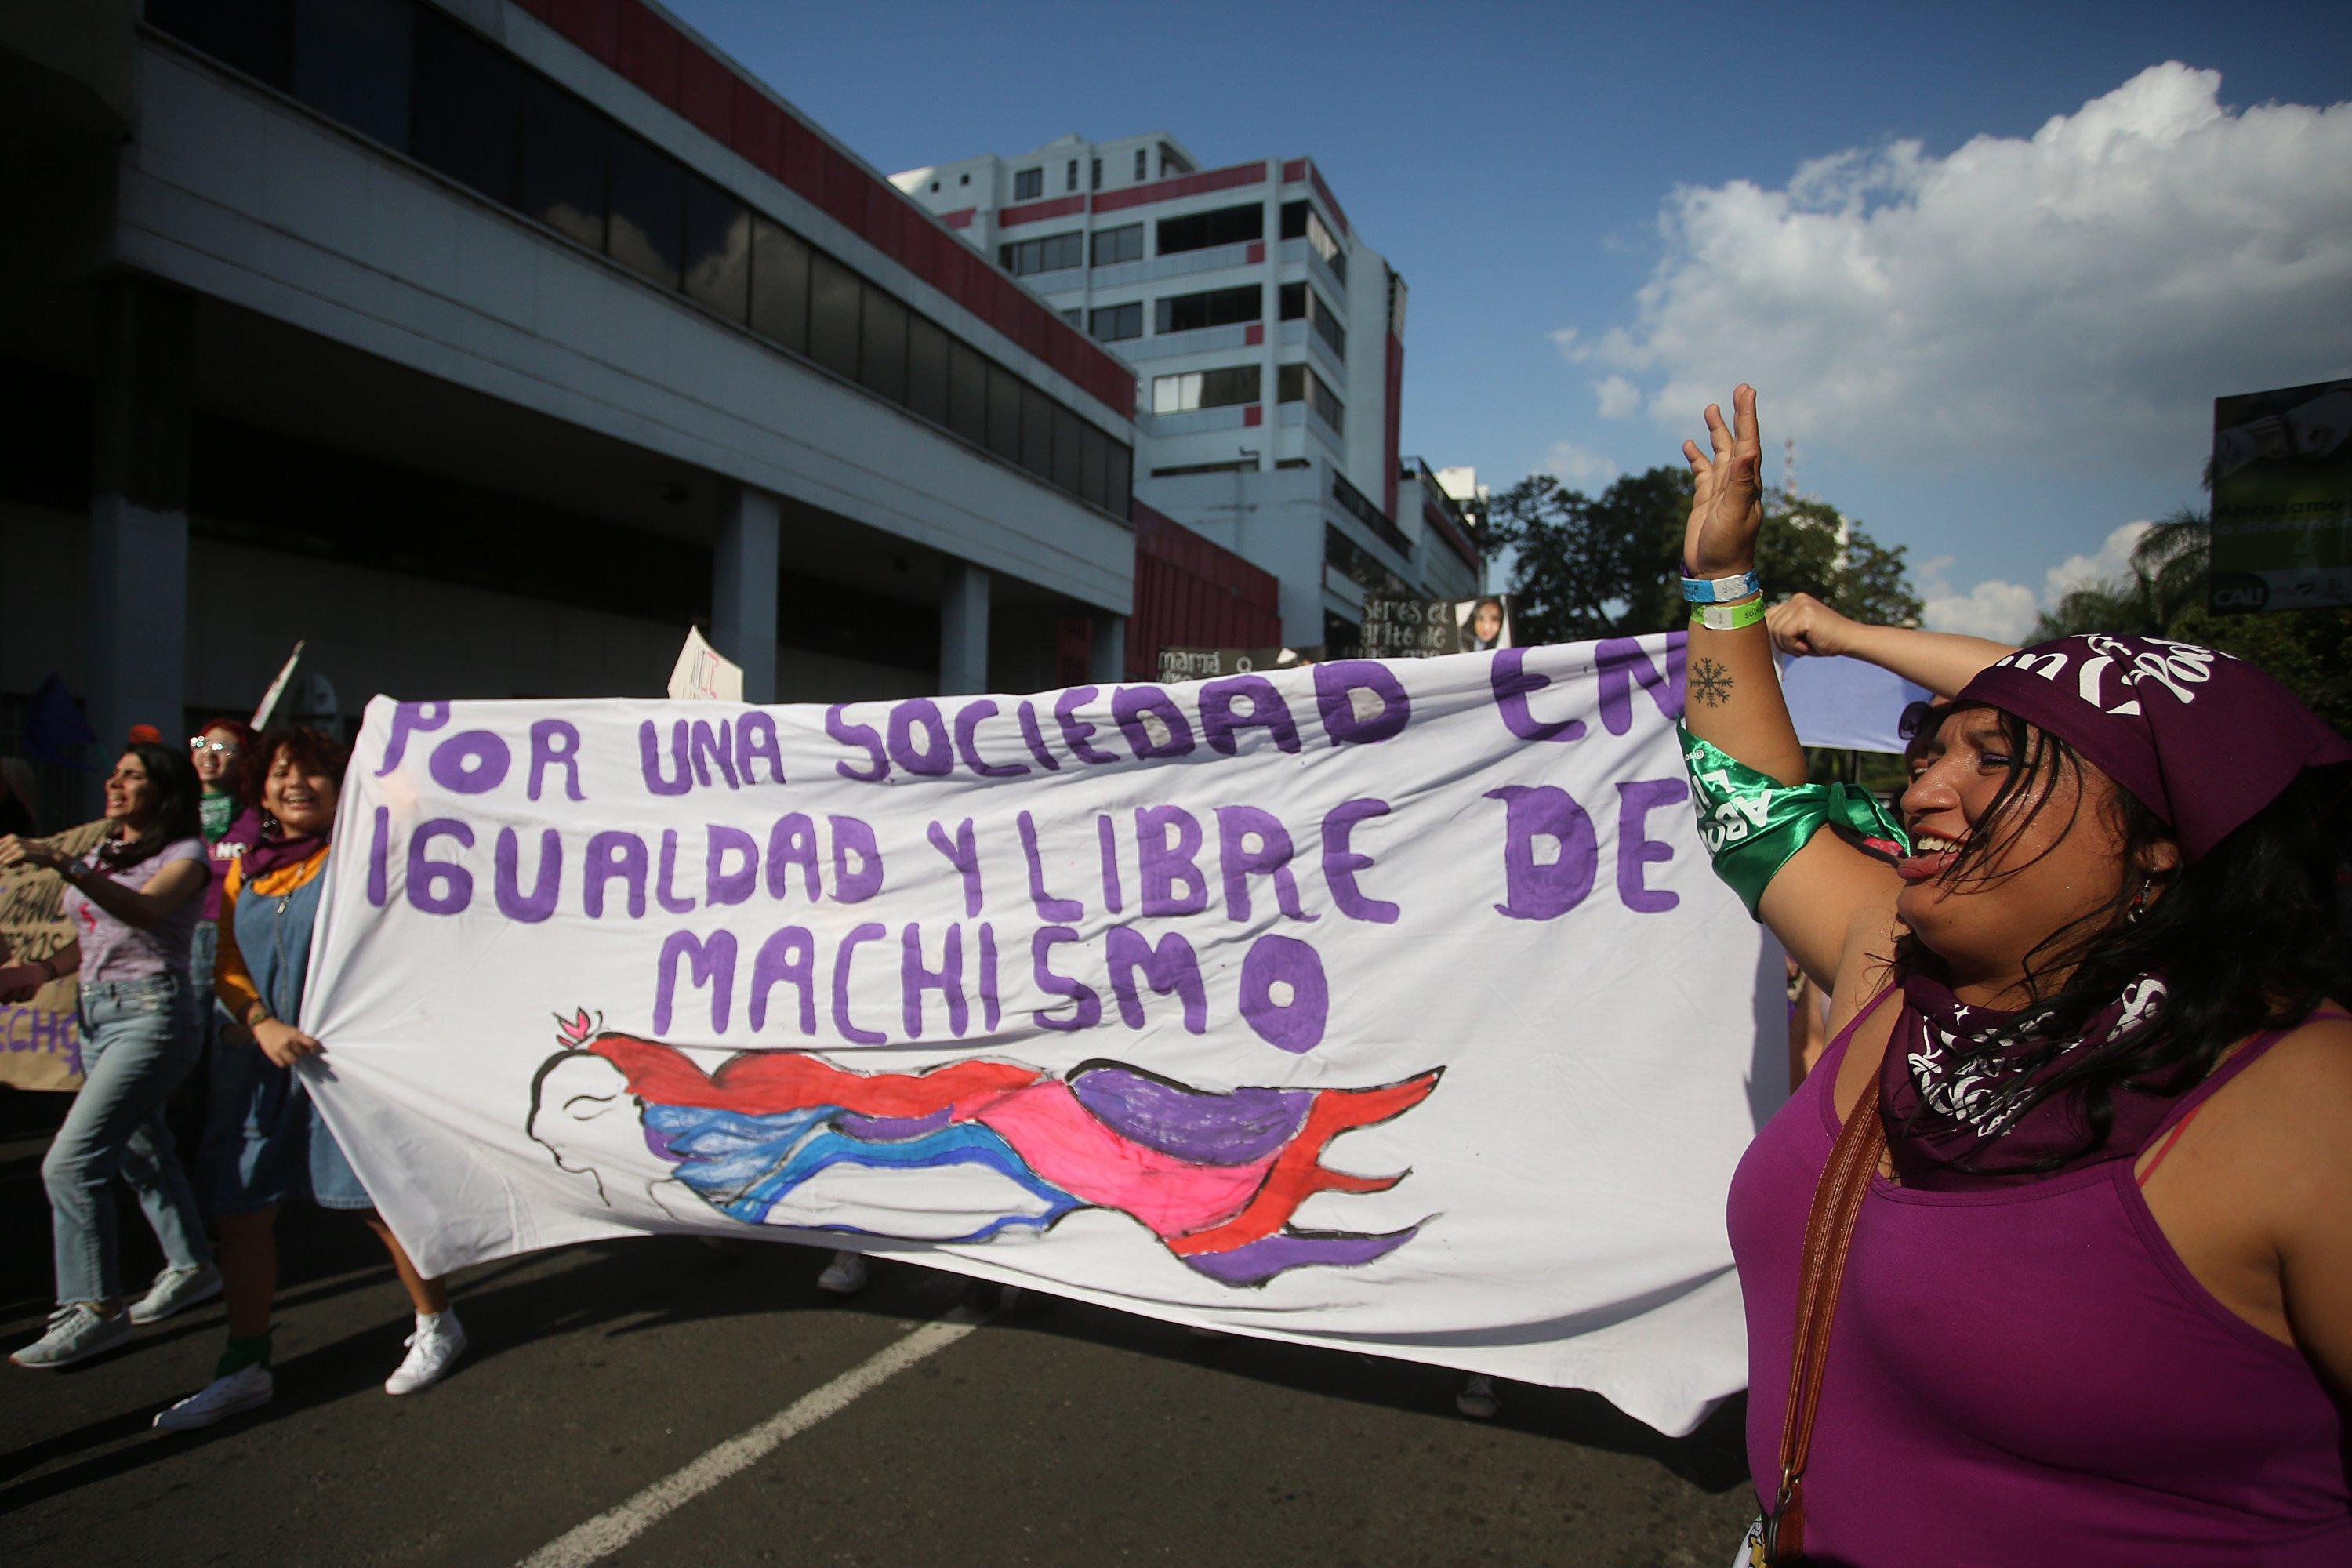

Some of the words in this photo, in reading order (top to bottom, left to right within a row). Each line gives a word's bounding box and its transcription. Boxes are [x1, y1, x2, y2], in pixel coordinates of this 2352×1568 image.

[377, 699, 583, 800] POR
[641, 711, 785, 795] UNA
[827, 661, 1410, 782] SOCIEDAD
[1491, 644, 1688, 741] EN
[367, 806, 884, 923] IGUALDAD
[928, 818, 983, 916] Y
[1018, 798, 1400, 924] LIBRE
[1485, 786, 1689, 920] DE
[655, 924, 1328, 1054] MACHISMO
